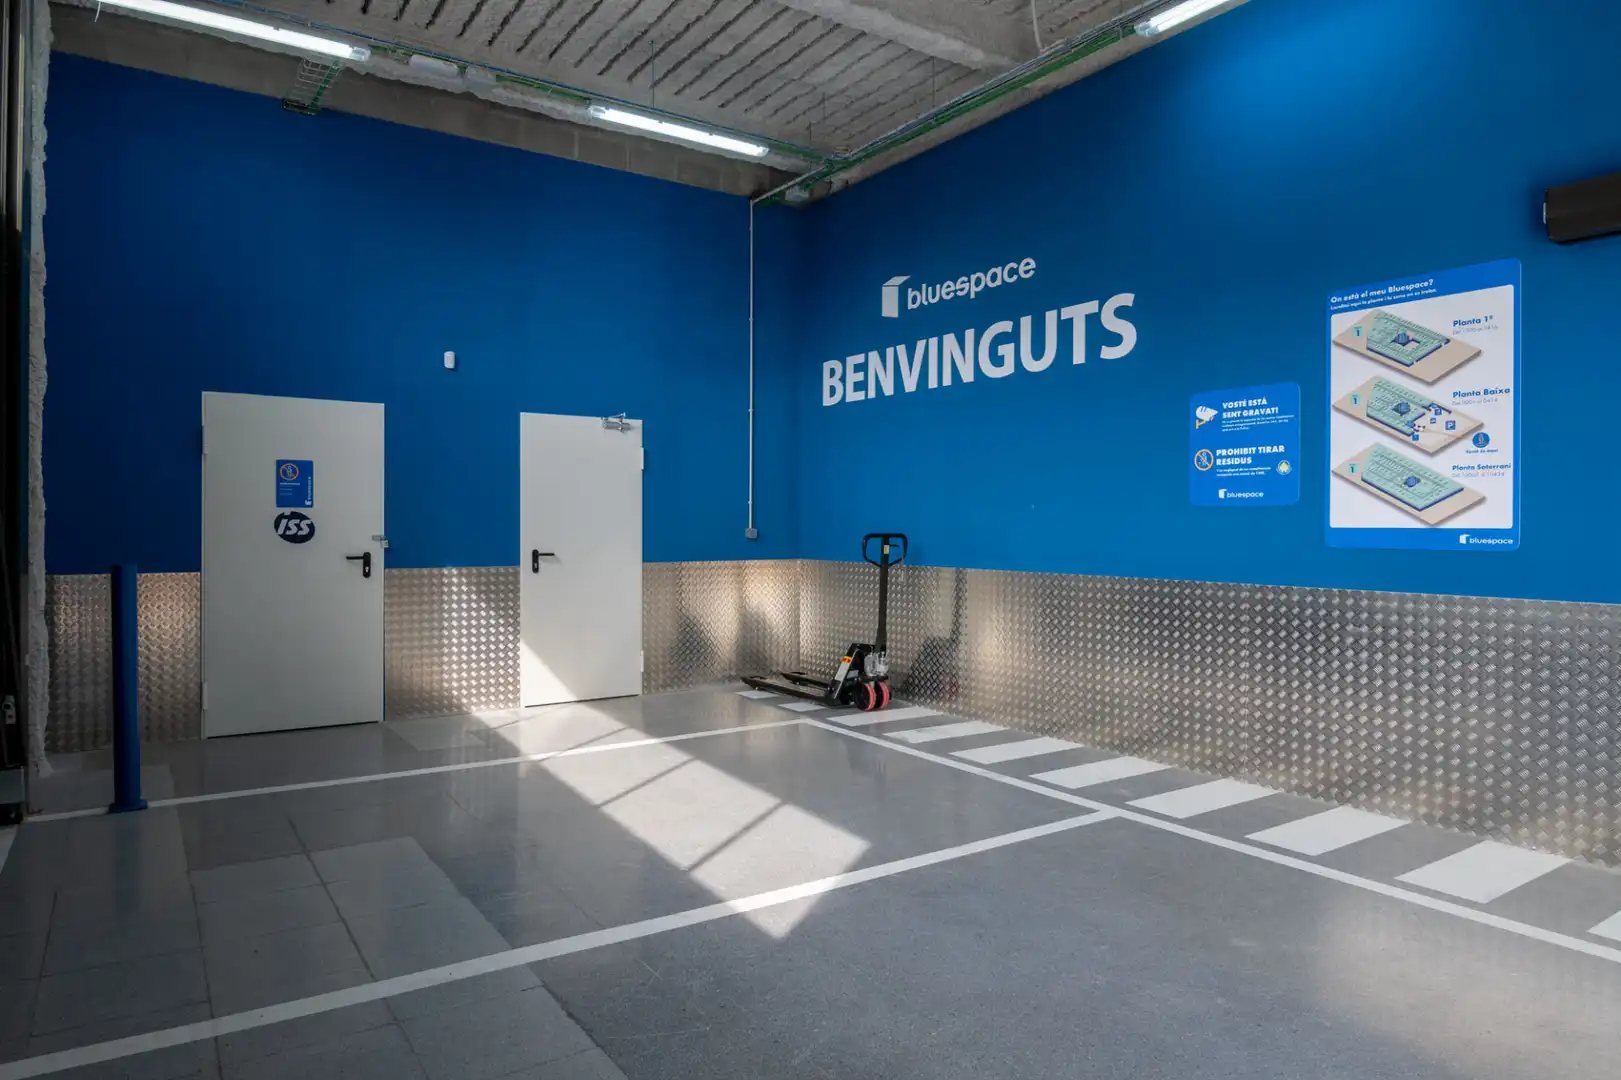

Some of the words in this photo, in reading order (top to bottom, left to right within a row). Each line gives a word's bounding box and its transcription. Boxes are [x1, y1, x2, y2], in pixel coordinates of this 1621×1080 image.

[907, 257, 1036, 310] bluespace
[1369, 289, 1387, 297] meu
[1388, 279, 1434, 293] Bluespace?
[1453, 318, 1481, 327] Planta
[822, 293, 1137, 407] BENVINGUTS
[1483, 387, 1510, 396] Baixa
[1222, 411, 1242, 419] SENT
[1216, 447, 1256, 457] PROHIBIT
[1258, 445, 1285, 454] TIRAR
[1216, 457, 1252, 466] RESIDUS
[1226, 490, 1264, 499] bluespace
[277, 519, 312, 535] ISS
[1469, 536, 1513, 545] bluespace
